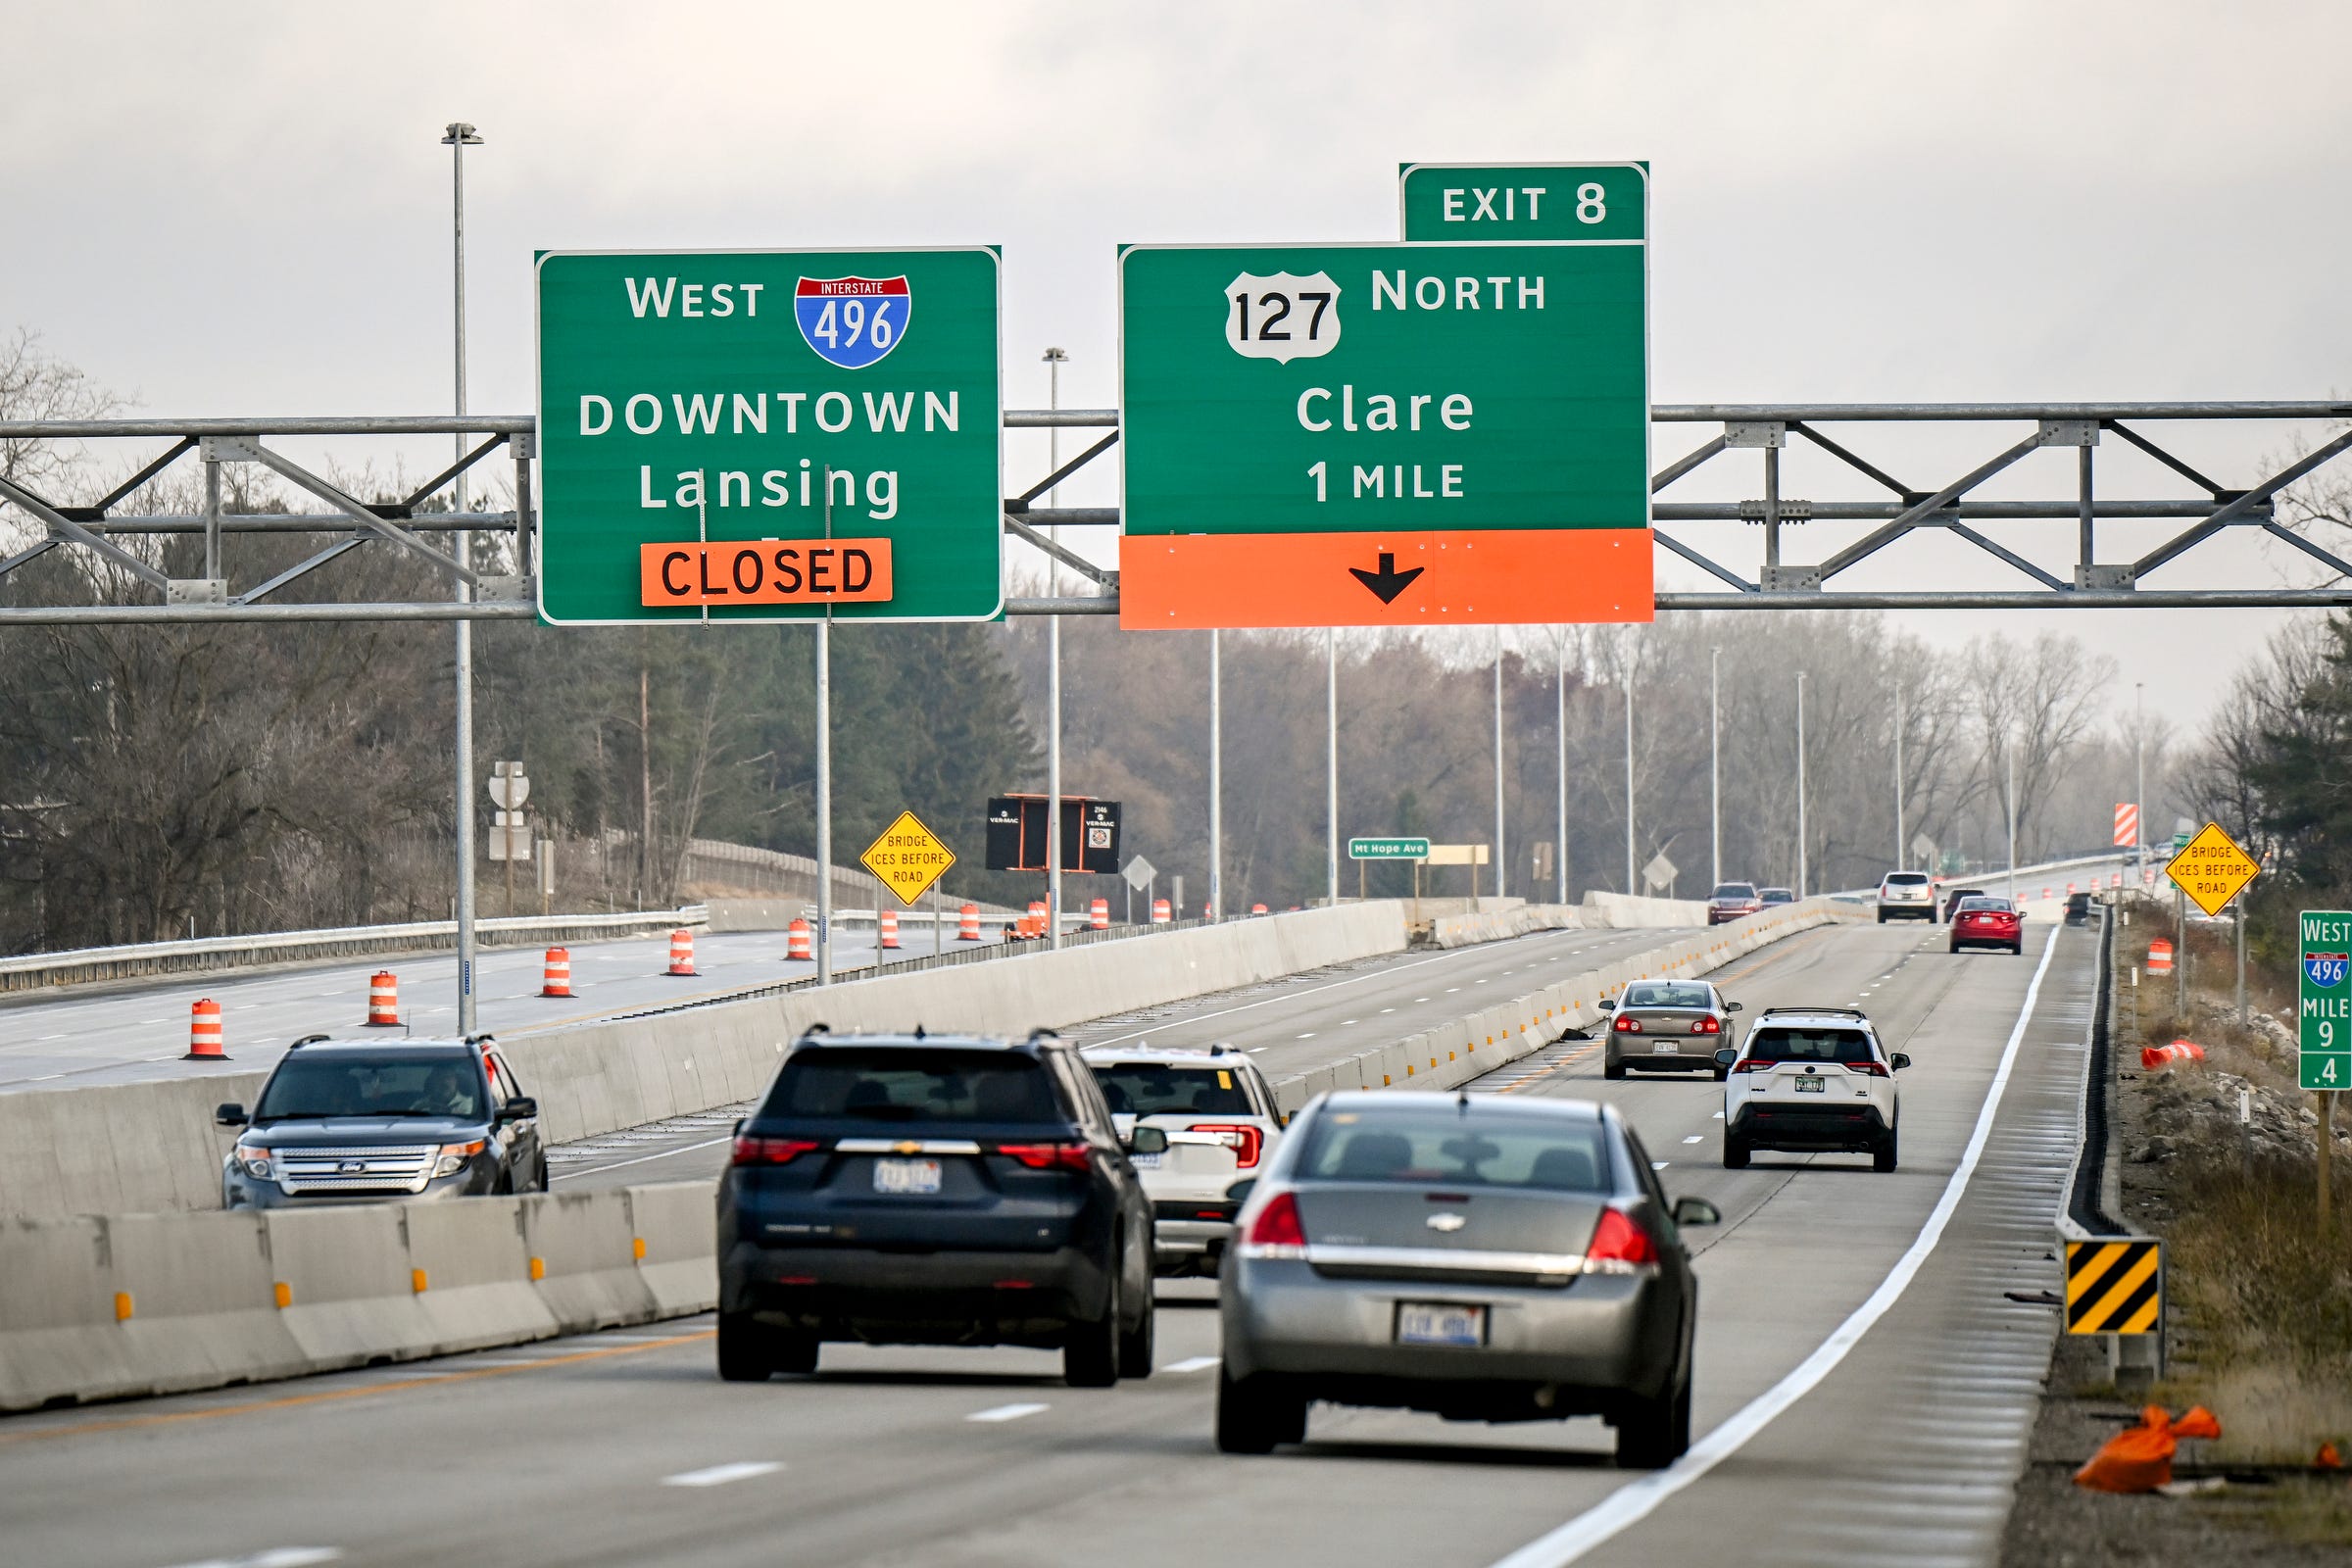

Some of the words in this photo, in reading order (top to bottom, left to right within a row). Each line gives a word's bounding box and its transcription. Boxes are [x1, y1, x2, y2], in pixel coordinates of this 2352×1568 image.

[1443, 187, 1546, 221] EXIT
[1575, 181, 1607, 224] 8
[624, 275, 764, 318] WEST
[820, 281, 884, 295] INTERSTATE
[1372, 270, 1545, 311] NORTH
[813, 299, 893, 350] 496
[1235, 292, 1332, 341] 127
[579, 391, 960, 436] DOWNTOWN
[1297, 384, 1474, 432] Clare
[640, 458, 899, 520] Lansing
[1306, 461, 1326, 503] 1
[1352, 465, 1464, 499] MILE
[661, 548, 873, 597] CLOSED
[888, 835, 928, 847] BRIDGE
[1371, 844, 1399, 855] Hope
[1403, 844, 1424, 853] Ave
[2191, 847, 2231, 858] BRIDGE
[871, 854, 896, 865] ICES
[902, 853, 945, 864] BEFORE
[2175, 864, 2199, 876] ICES
[2205, 864, 2249, 876] BEFORE
[893, 871, 923, 882] ROAD
[2197, 882, 2227, 894] ROAD
[2303, 919, 2350, 942] WEST
[2311, 961, 2342, 981] 496
[2303, 998, 2349, 1018] MILE
[2319, 1020, 2333, 1048] 9
[2314, 1057, 2337, 1084] .4
